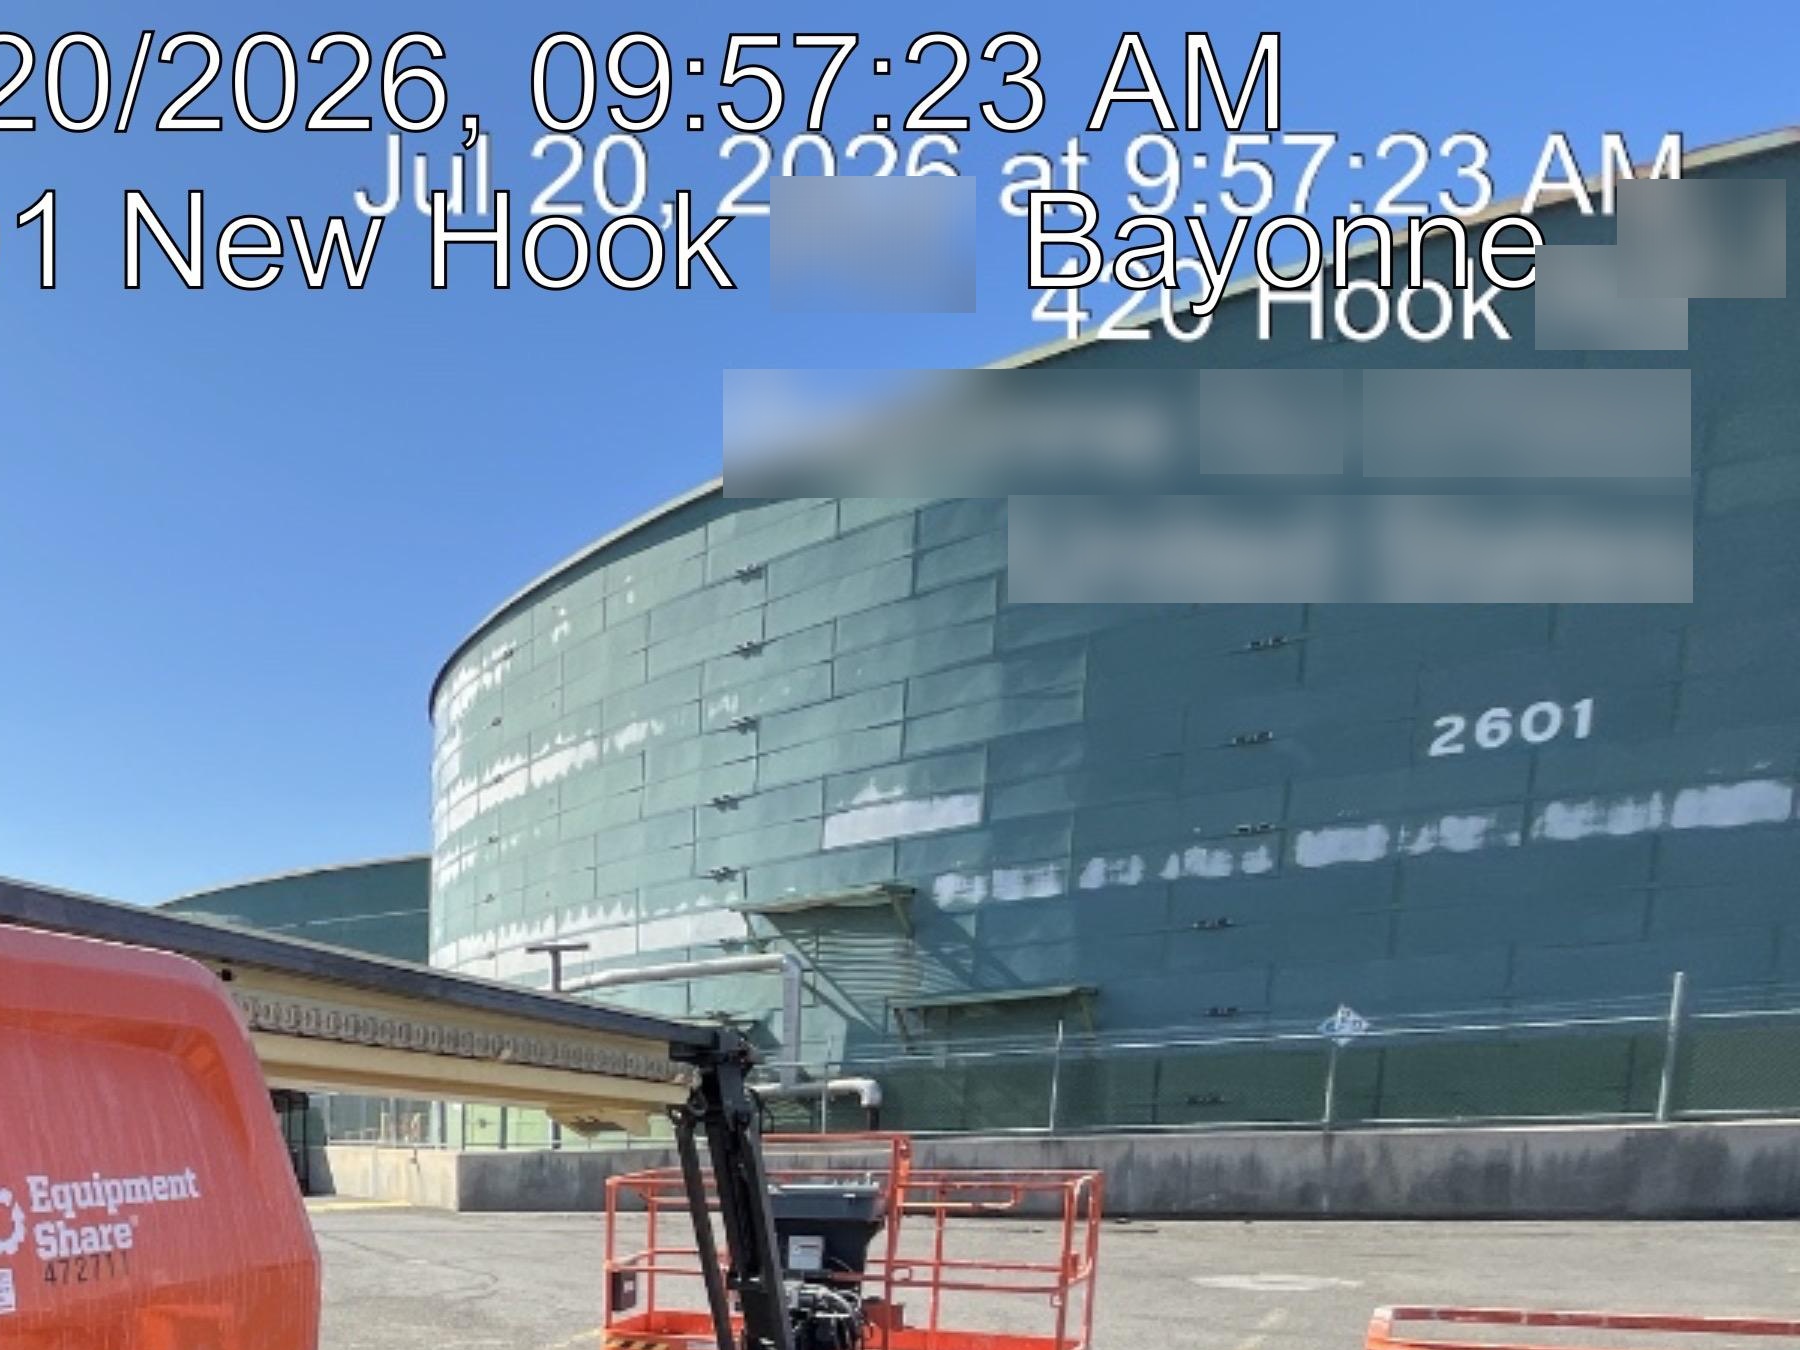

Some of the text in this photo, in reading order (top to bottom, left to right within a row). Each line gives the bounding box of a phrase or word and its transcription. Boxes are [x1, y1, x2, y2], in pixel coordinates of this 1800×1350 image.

[1428, 697, 1594, 757] 2601
[26, 1167, 200, 1218] Equipment
[33, 1219, 133, 1261] Share
